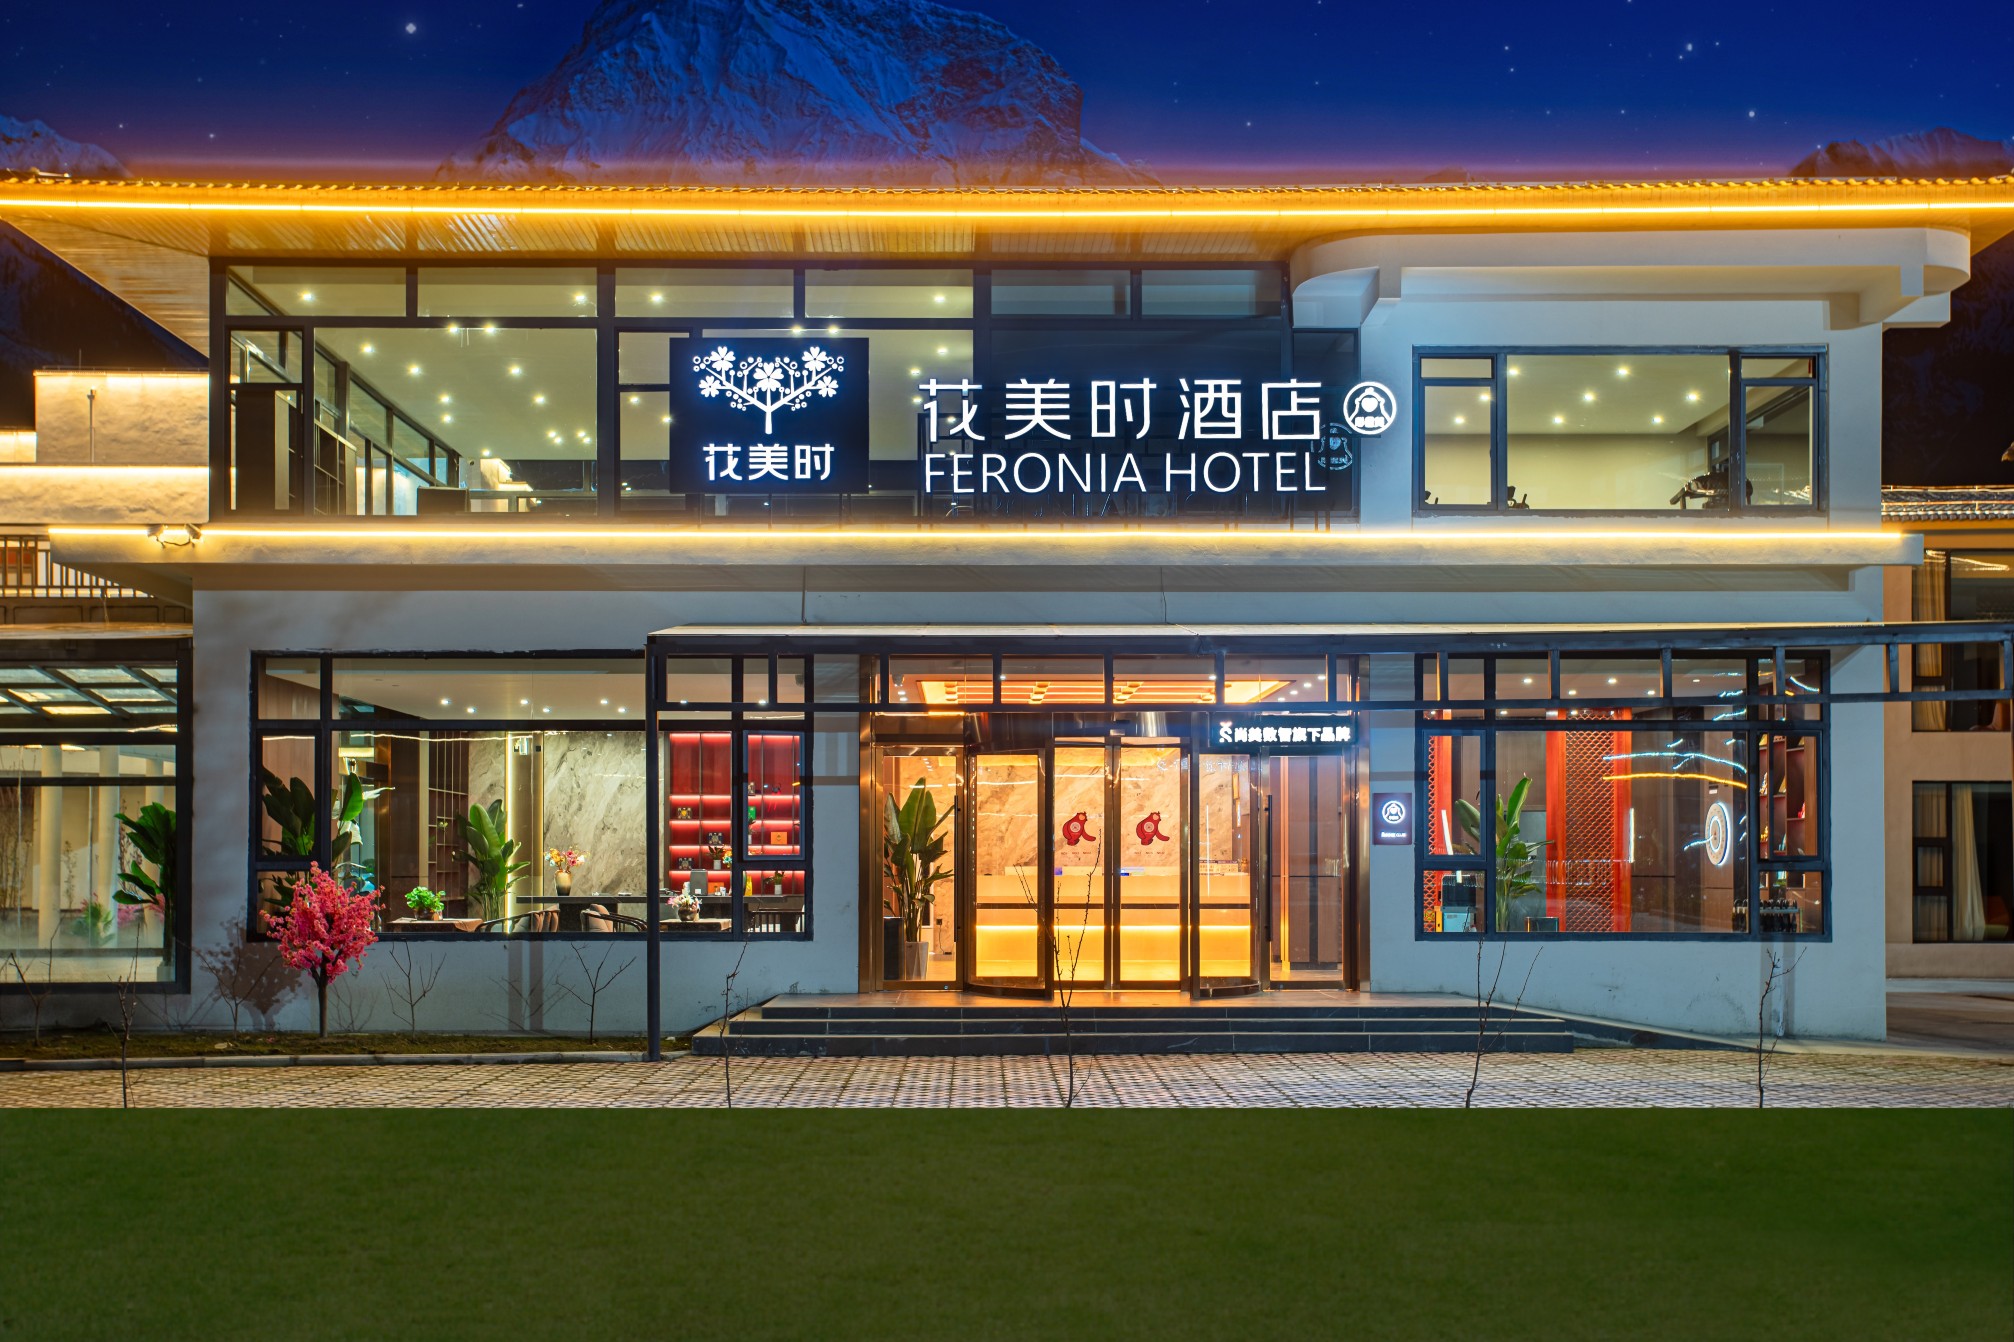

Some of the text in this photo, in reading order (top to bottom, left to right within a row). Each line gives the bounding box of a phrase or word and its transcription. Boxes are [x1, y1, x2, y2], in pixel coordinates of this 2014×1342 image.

[918, 378, 1322, 442] 花美时酒店
[703, 443, 836, 481] 花美时
[923, 451, 1326, 493] FERONIA HOTEL
